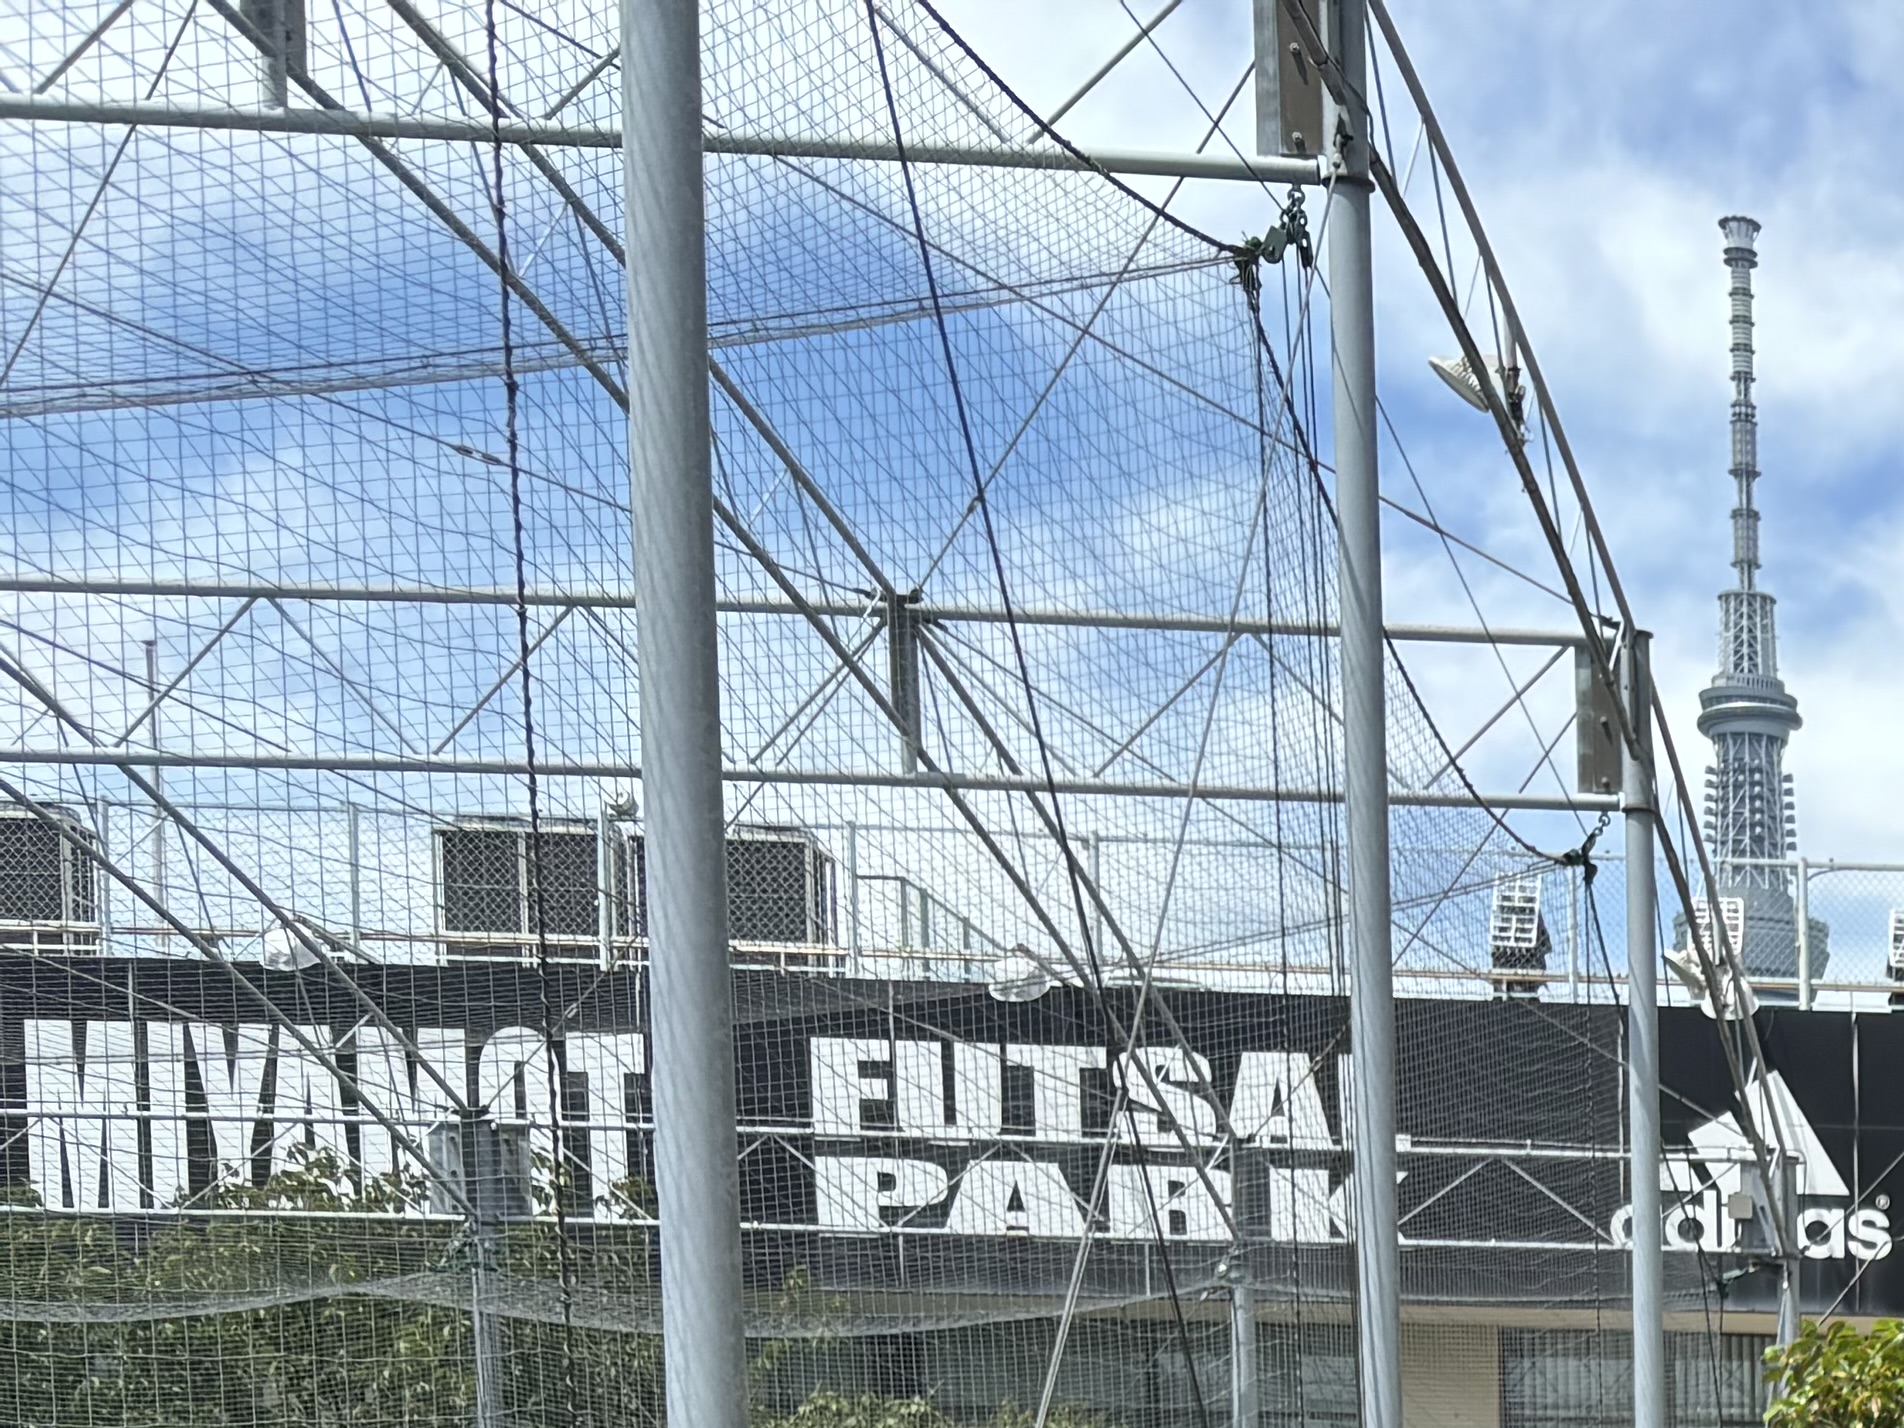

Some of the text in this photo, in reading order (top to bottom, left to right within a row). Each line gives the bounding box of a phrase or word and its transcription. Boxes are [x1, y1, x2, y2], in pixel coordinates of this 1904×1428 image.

[24, 1019, 650, 1213] MIYAMOT
[810, 1036, 1354, 1150] FUTSA
[815, 1156, 1408, 1244] PARK
[1610, 1188, 1893, 1262] dias
